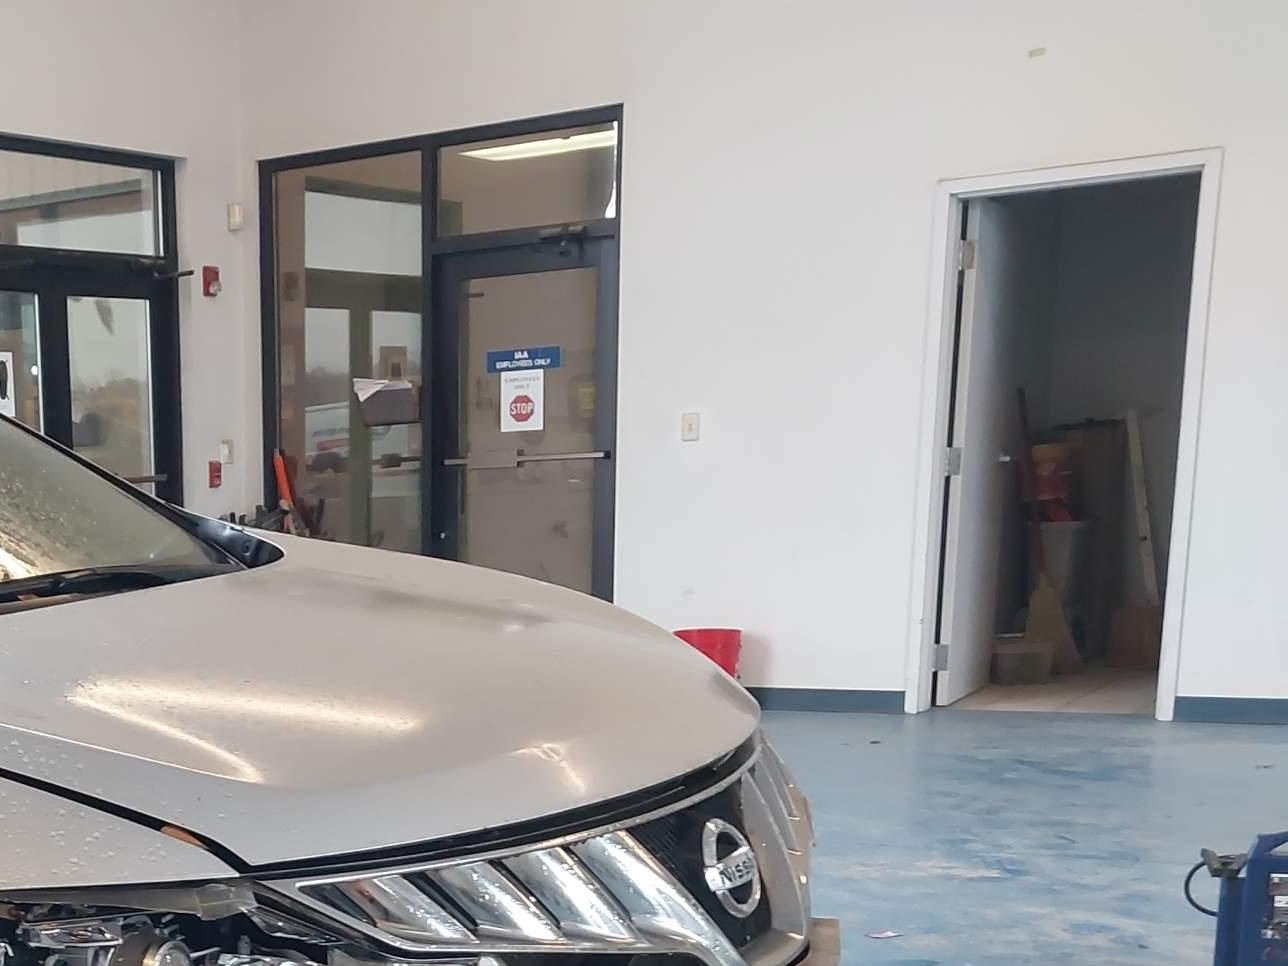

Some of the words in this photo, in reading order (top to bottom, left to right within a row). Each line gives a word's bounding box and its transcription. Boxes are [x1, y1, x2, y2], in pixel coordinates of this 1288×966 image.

[514, 351, 529, 359] IAA
[495, 359, 533, 369] EMPLOYEES
[534, 358, 551, 366] ONLY
[510, 402, 534, 415] STOP
